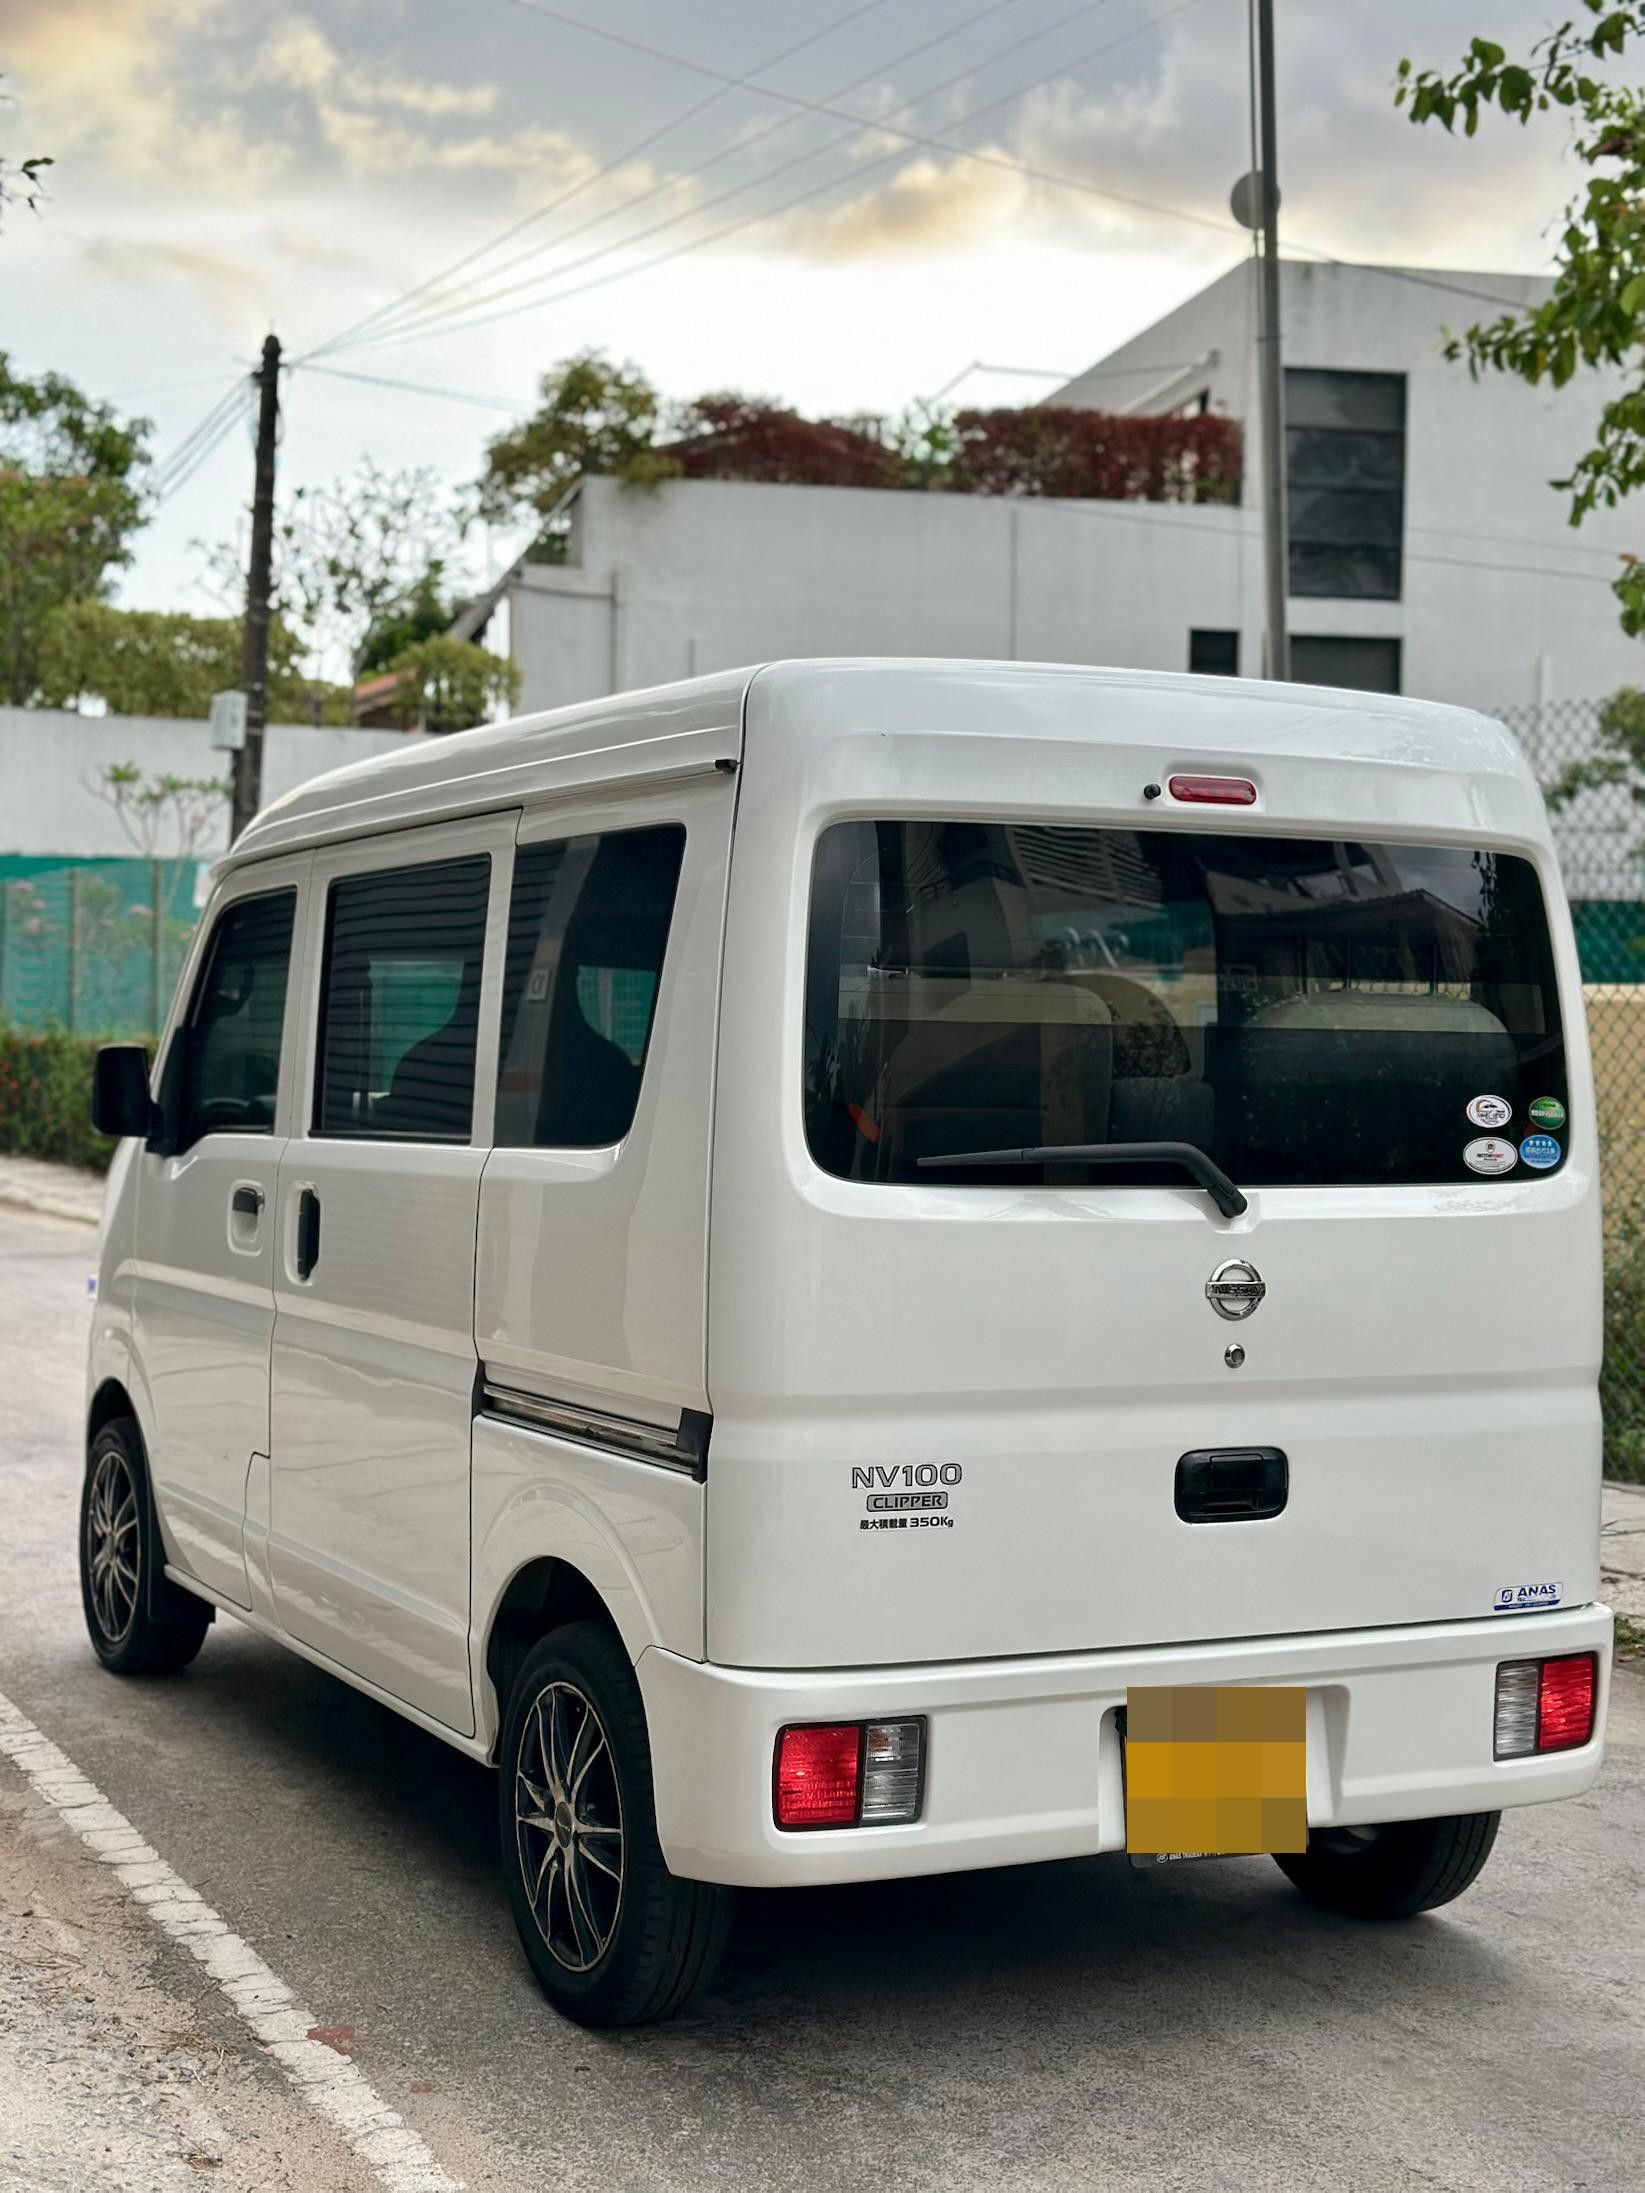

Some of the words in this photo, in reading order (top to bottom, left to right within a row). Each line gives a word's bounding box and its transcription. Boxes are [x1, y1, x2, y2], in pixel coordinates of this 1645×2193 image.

[851, 1463, 962, 1489] NV100
[873, 1495, 942, 1508] CLIPPER
[909, 1516, 954, 1528] 350Kg
[1517, 1584, 1556, 1597] ANAS
